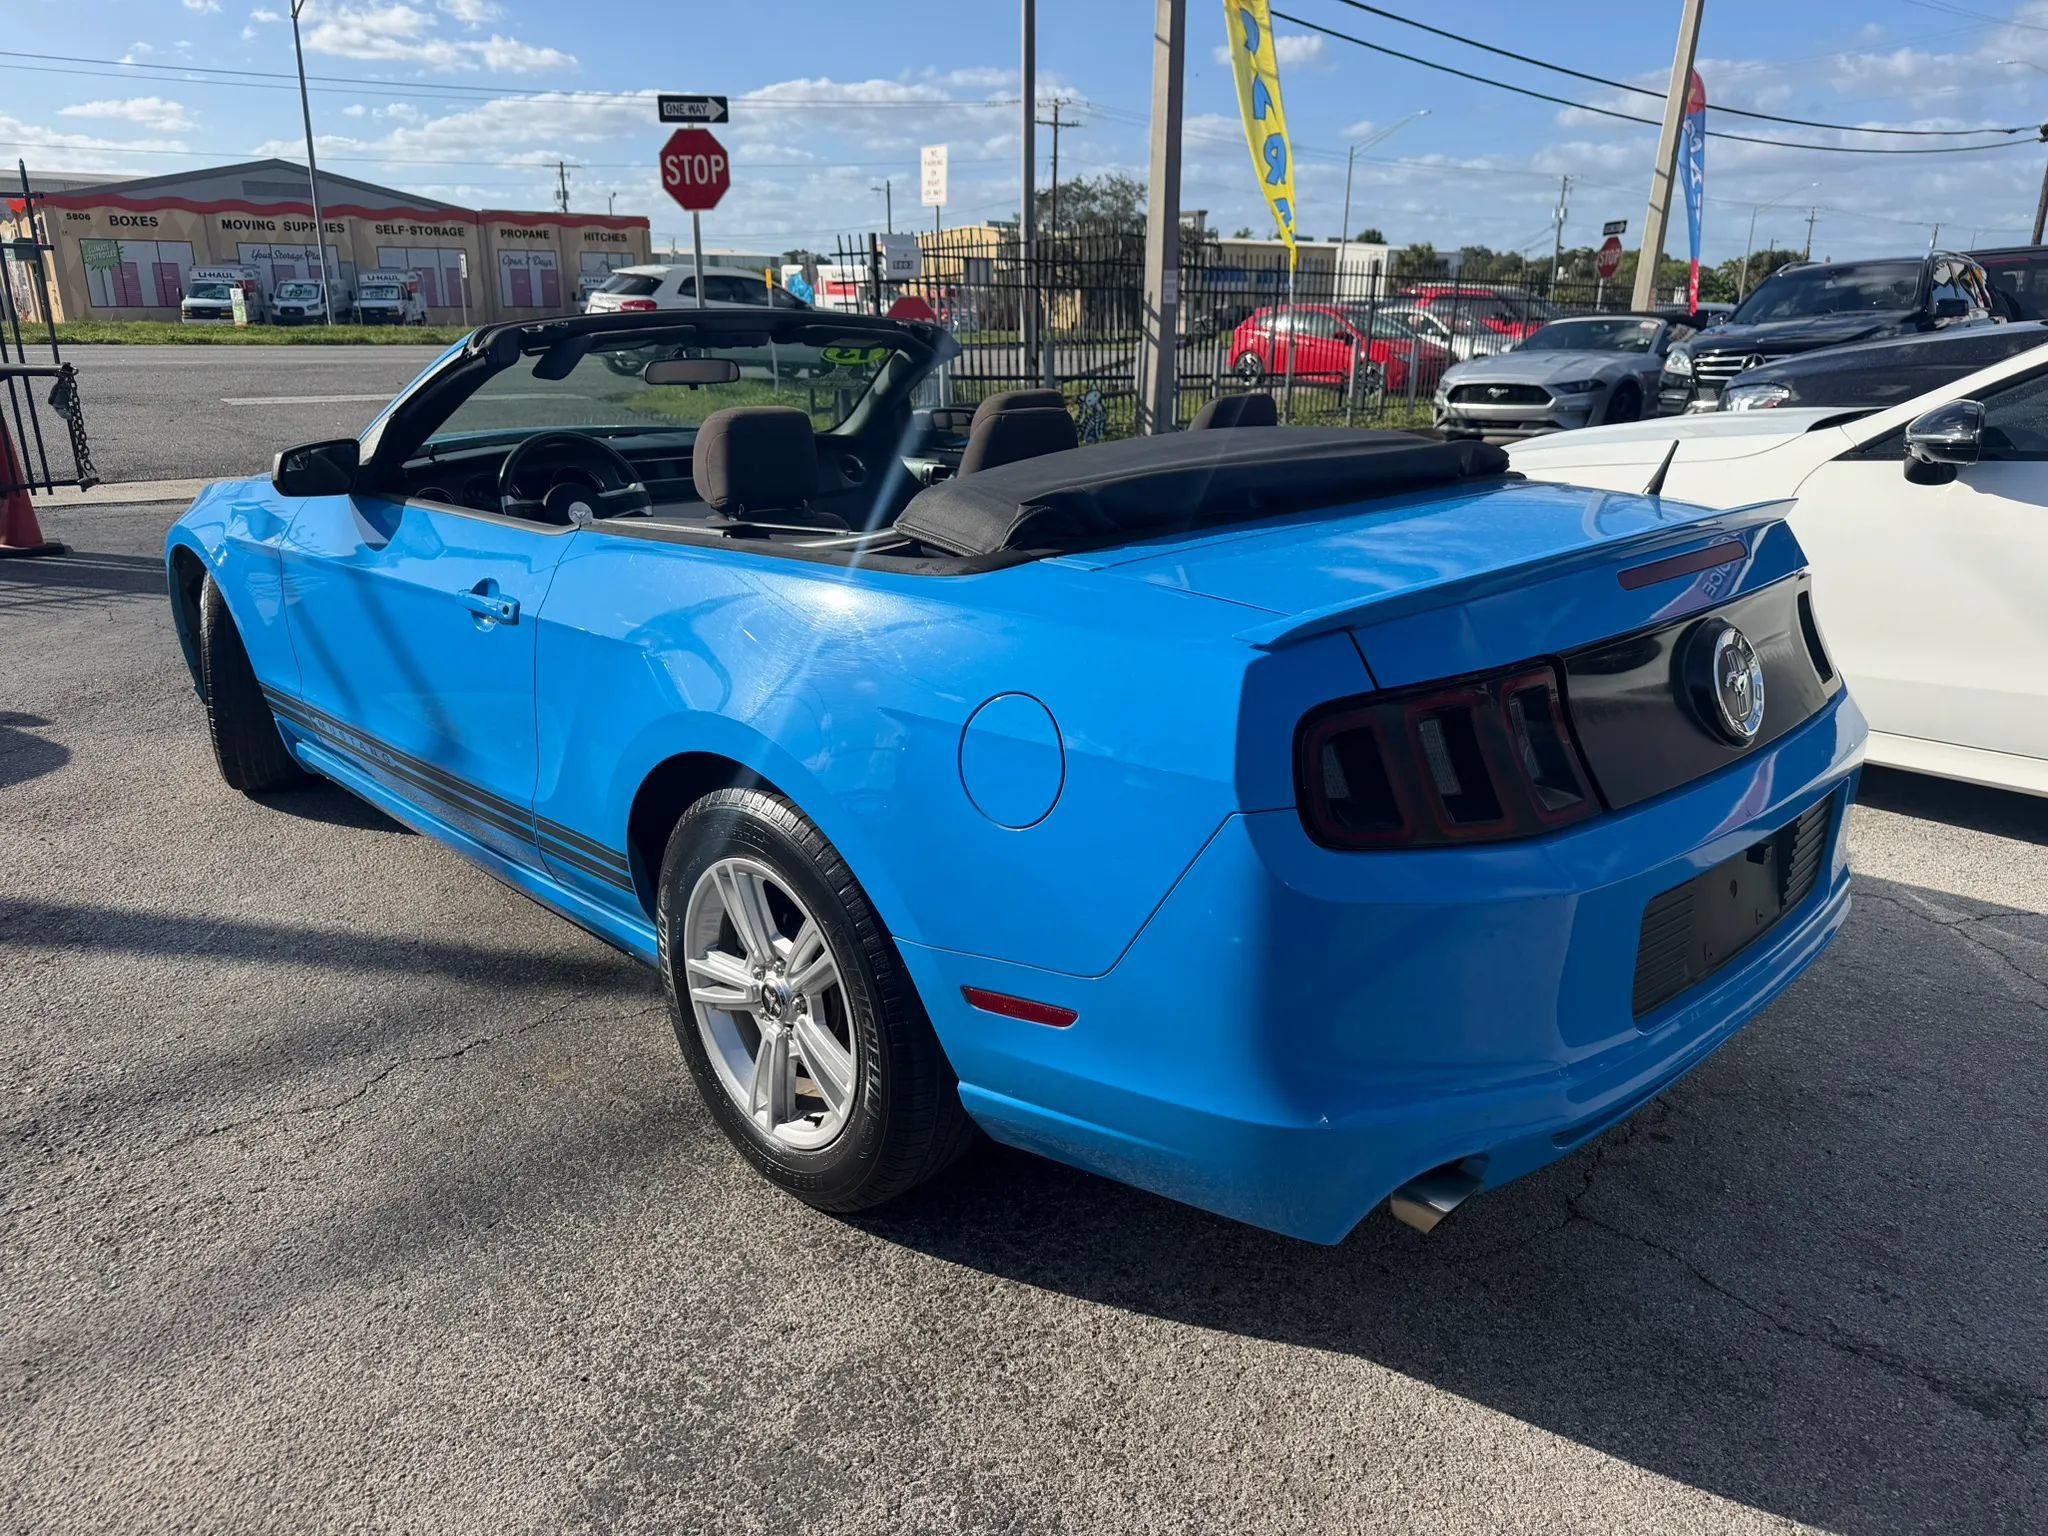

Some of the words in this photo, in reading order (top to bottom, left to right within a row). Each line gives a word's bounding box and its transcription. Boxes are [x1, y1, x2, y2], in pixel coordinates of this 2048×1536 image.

[665, 103, 685, 114] ONE
[687, 103, 707, 114] WAY
[665, 154, 725, 186] STOP
[66, 212, 91, 221] 5806
[109, 215, 159, 227] BOXES
[221, 219, 276, 231] MOVING
[283, 221, 345, 233] SUPPIES
[375, 224, 465, 237] SELF-STORAGE
[500, 228, 550, 240] PROPANE
[584, 232, 628, 242] HITCHES
[198, 271, 235, 279] U-HAUL
[317, 719, 392, 765] MUSTANG
